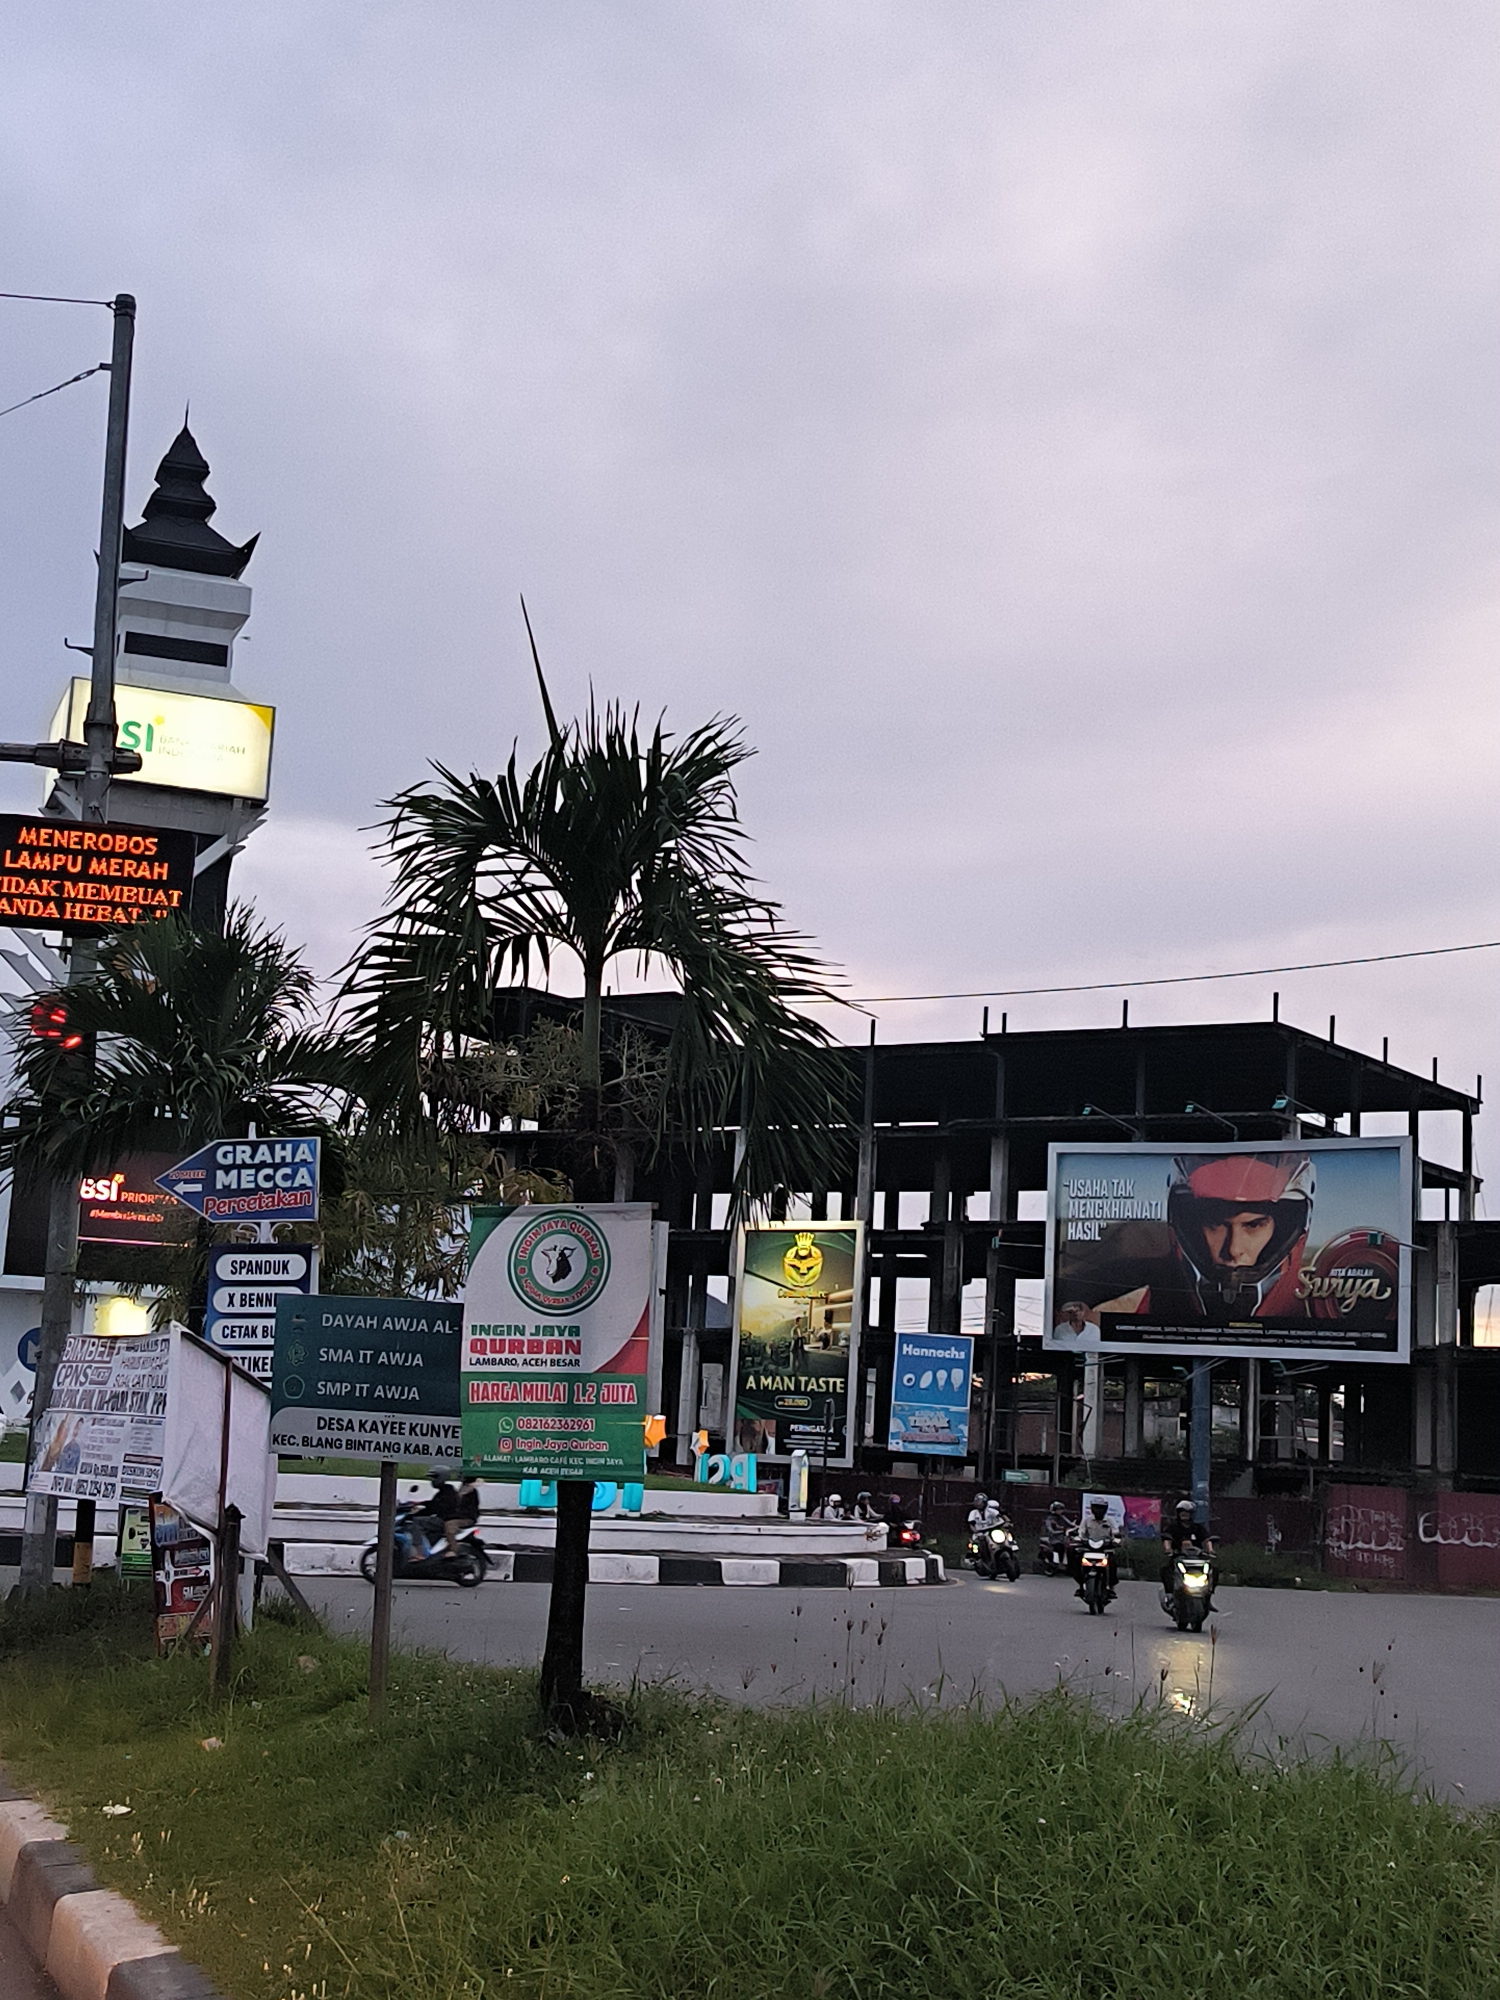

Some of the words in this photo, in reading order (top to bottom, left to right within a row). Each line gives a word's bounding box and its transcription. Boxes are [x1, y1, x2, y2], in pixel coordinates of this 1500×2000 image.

[18, 827, 158, 855] MENEROBOS
[4, 849, 82, 873] LAMPU
[89, 857, 169, 880] MERAH
[62, 881, 183, 907] MEMBUAT
[216, 1144, 314, 1165] GRAHA
[216, 1167, 313, 1189] MECCA
[80, 1178, 119, 1201] BSI
[1112, 1179, 1135, 1198] TAK
[204, 1189, 312, 1215] Percetakan
[1068, 1200, 1162, 1220] MENGKHIANATI
[540, 1219, 568, 1233] JAYA
[569, 1221, 601, 1259] QURBAN
[230, 1260, 290, 1275] SPANDUK
[1295, 1266, 1392, 1313] Surya
[227, 1293, 236, 1307] X
[222, 1325, 258, 1339] CETAK
[321, 1313, 378, 1330] DAYAH
[382, 1316, 429, 1333] AWJA
[471, 1324, 526, 1336] INGIN
[530, 1325, 581, 1336] JAYA
[62, 1338, 113, 1362] BIMBEL
[469, 1338, 581, 1355] QURBAN
[902, 1343, 965, 1359] Hannochs
[318, 1347, 354, 1362] SMA
[358, 1349, 374, 1364] IT
[378, 1351, 424, 1367] AWJA
[469, 1357, 520, 1368] LAMBARO,
[521, 1358, 548, 1367] ACEH
[550, 1358, 581, 1367] BESAR
[56, 1364, 93, 1387] CPNS
[746, 1375, 757, 1390] A
[760, 1376, 795, 1391] MAN
[798, 1376, 845, 1393] TASTE
[317, 1381, 351, 1396] SMP
[355, 1383, 370, 1397] IT
[374, 1384, 420, 1400] AWJA
[469, 1382, 520, 1404] HARGA
[522, 1382, 567, 1404] MULAI
[574, 1382, 596, 1404] 1.2
[600, 1382, 637, 1405] JUTA
[316, 1416, 356, 1432] DESA
[358, 1418, 406, 1436] KAYEE
[516, 1416, 595, 1432] 082162362961
[272, 1434, 299, 1447] KEC.
[301, 1435, 343, 1450] BLANG
[345, 1439, 401, 1454] BINTANG
[404, 1442, 433, 1457] KAB.
[543, 1438, 568, 1452] Jaya
[570, 1439, 609, 1451] Qurban
